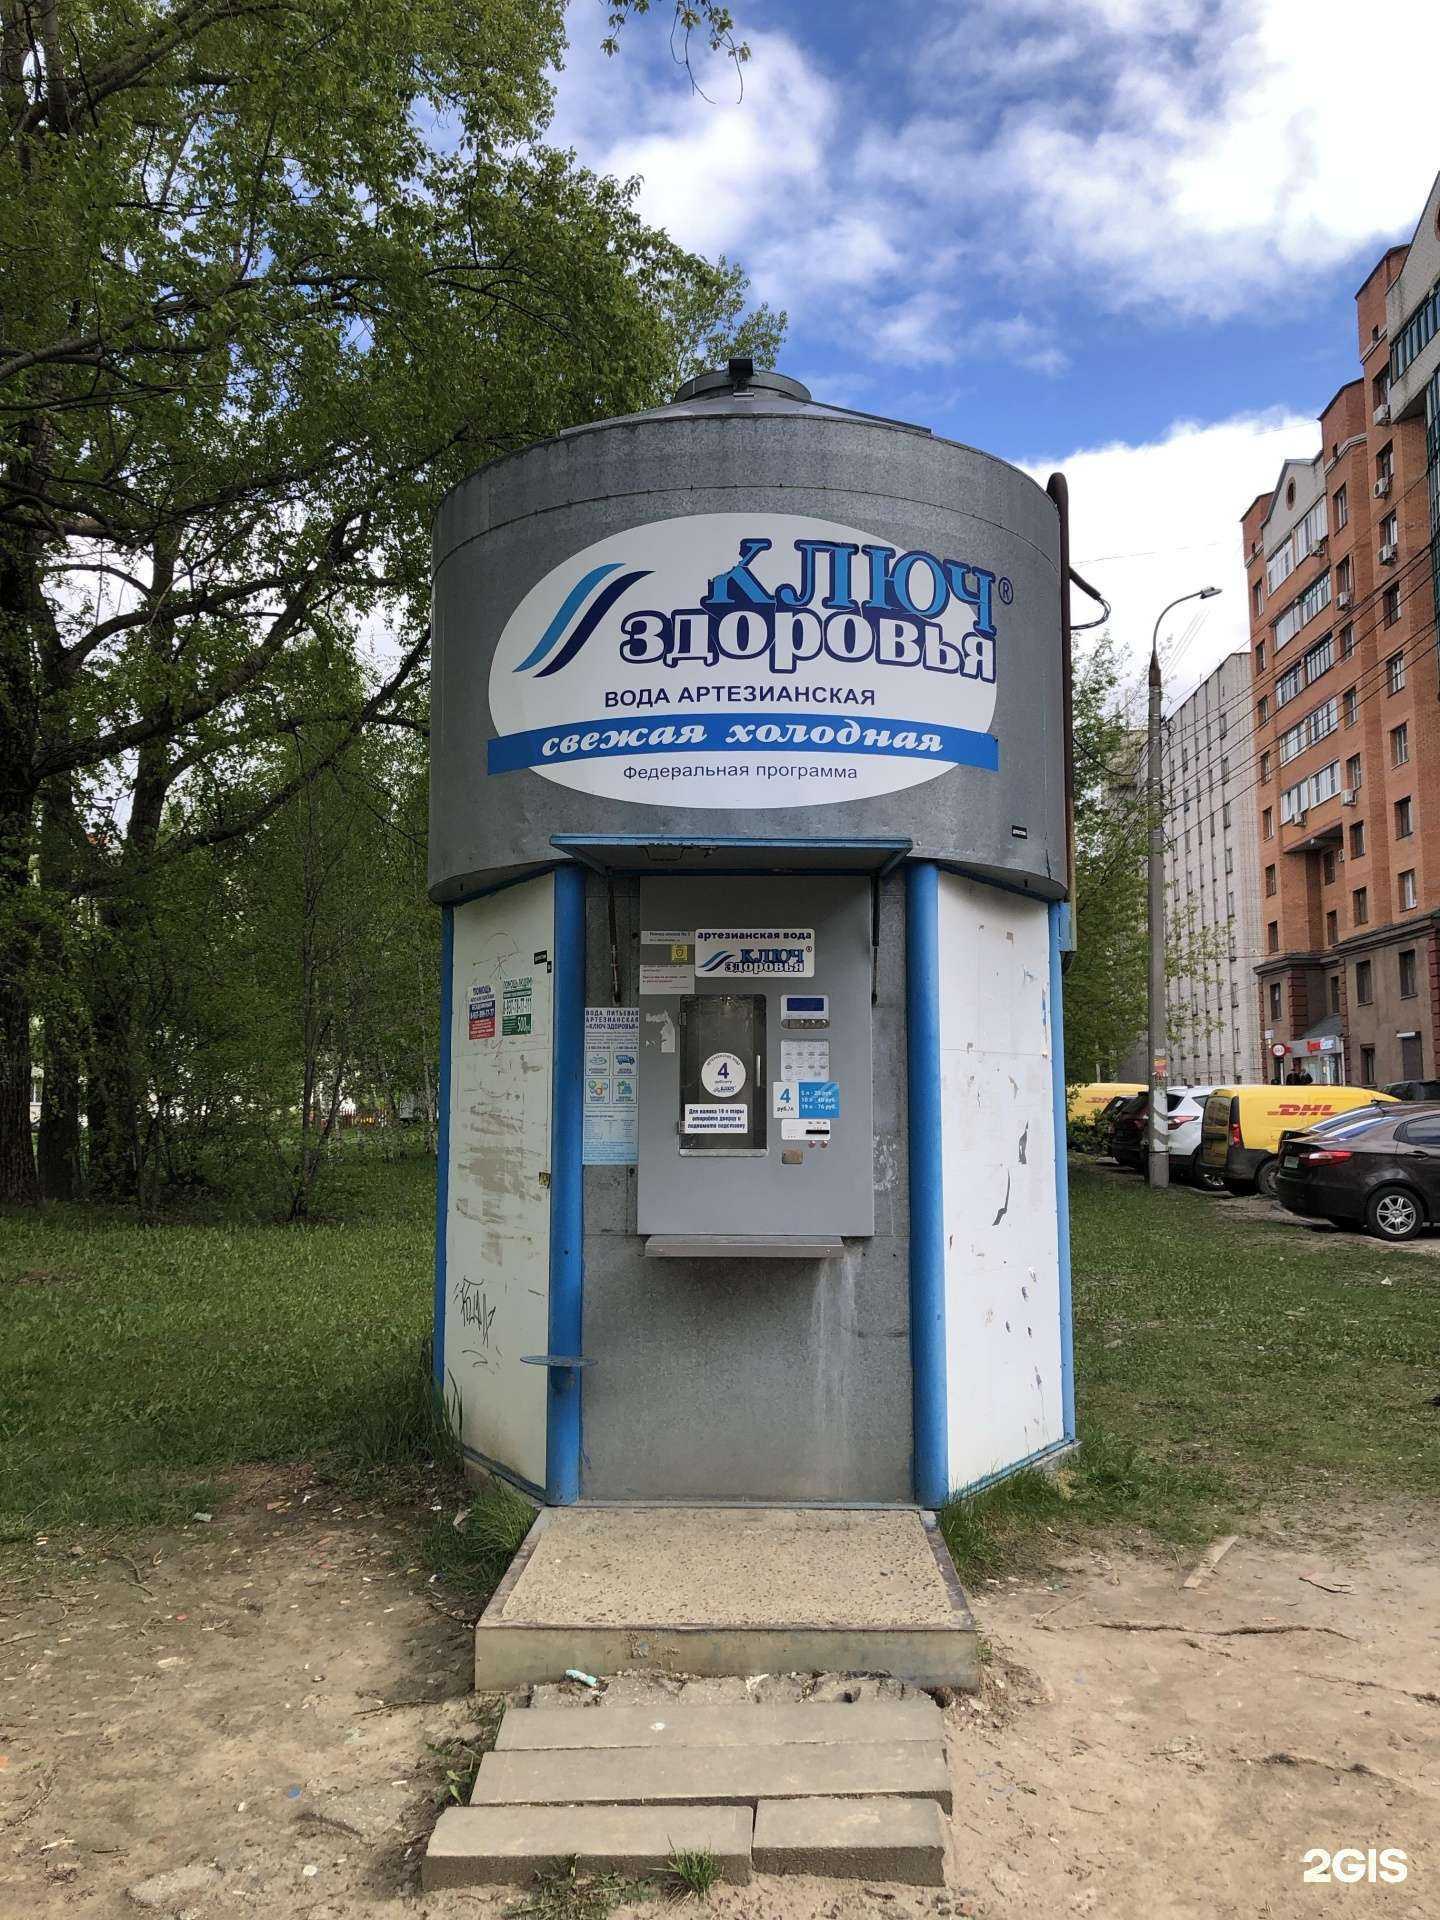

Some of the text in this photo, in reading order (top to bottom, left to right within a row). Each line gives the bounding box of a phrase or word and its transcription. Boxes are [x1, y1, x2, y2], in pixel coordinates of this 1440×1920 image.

[701, 538, 996, 634] КЛЮЧ
[620, 605, 996, 683] здоровья
[605, 685, 875, 708] ВОДА АРТЕЗИАНСКАЯ
[542, 719, 943, 756] свежая холодная
[623, 763, 858, 781] Федеральная программа
[697, 931, 780, 941] артезианская
[783, 931, 812, 940] вода
[740, 949, 804, 963] КЛЮЧ
[717, 1062, 730, 1079] 4
[779, 1088, 791, 1103] 4
[1278, 1104, 1338, 1116] DHL
